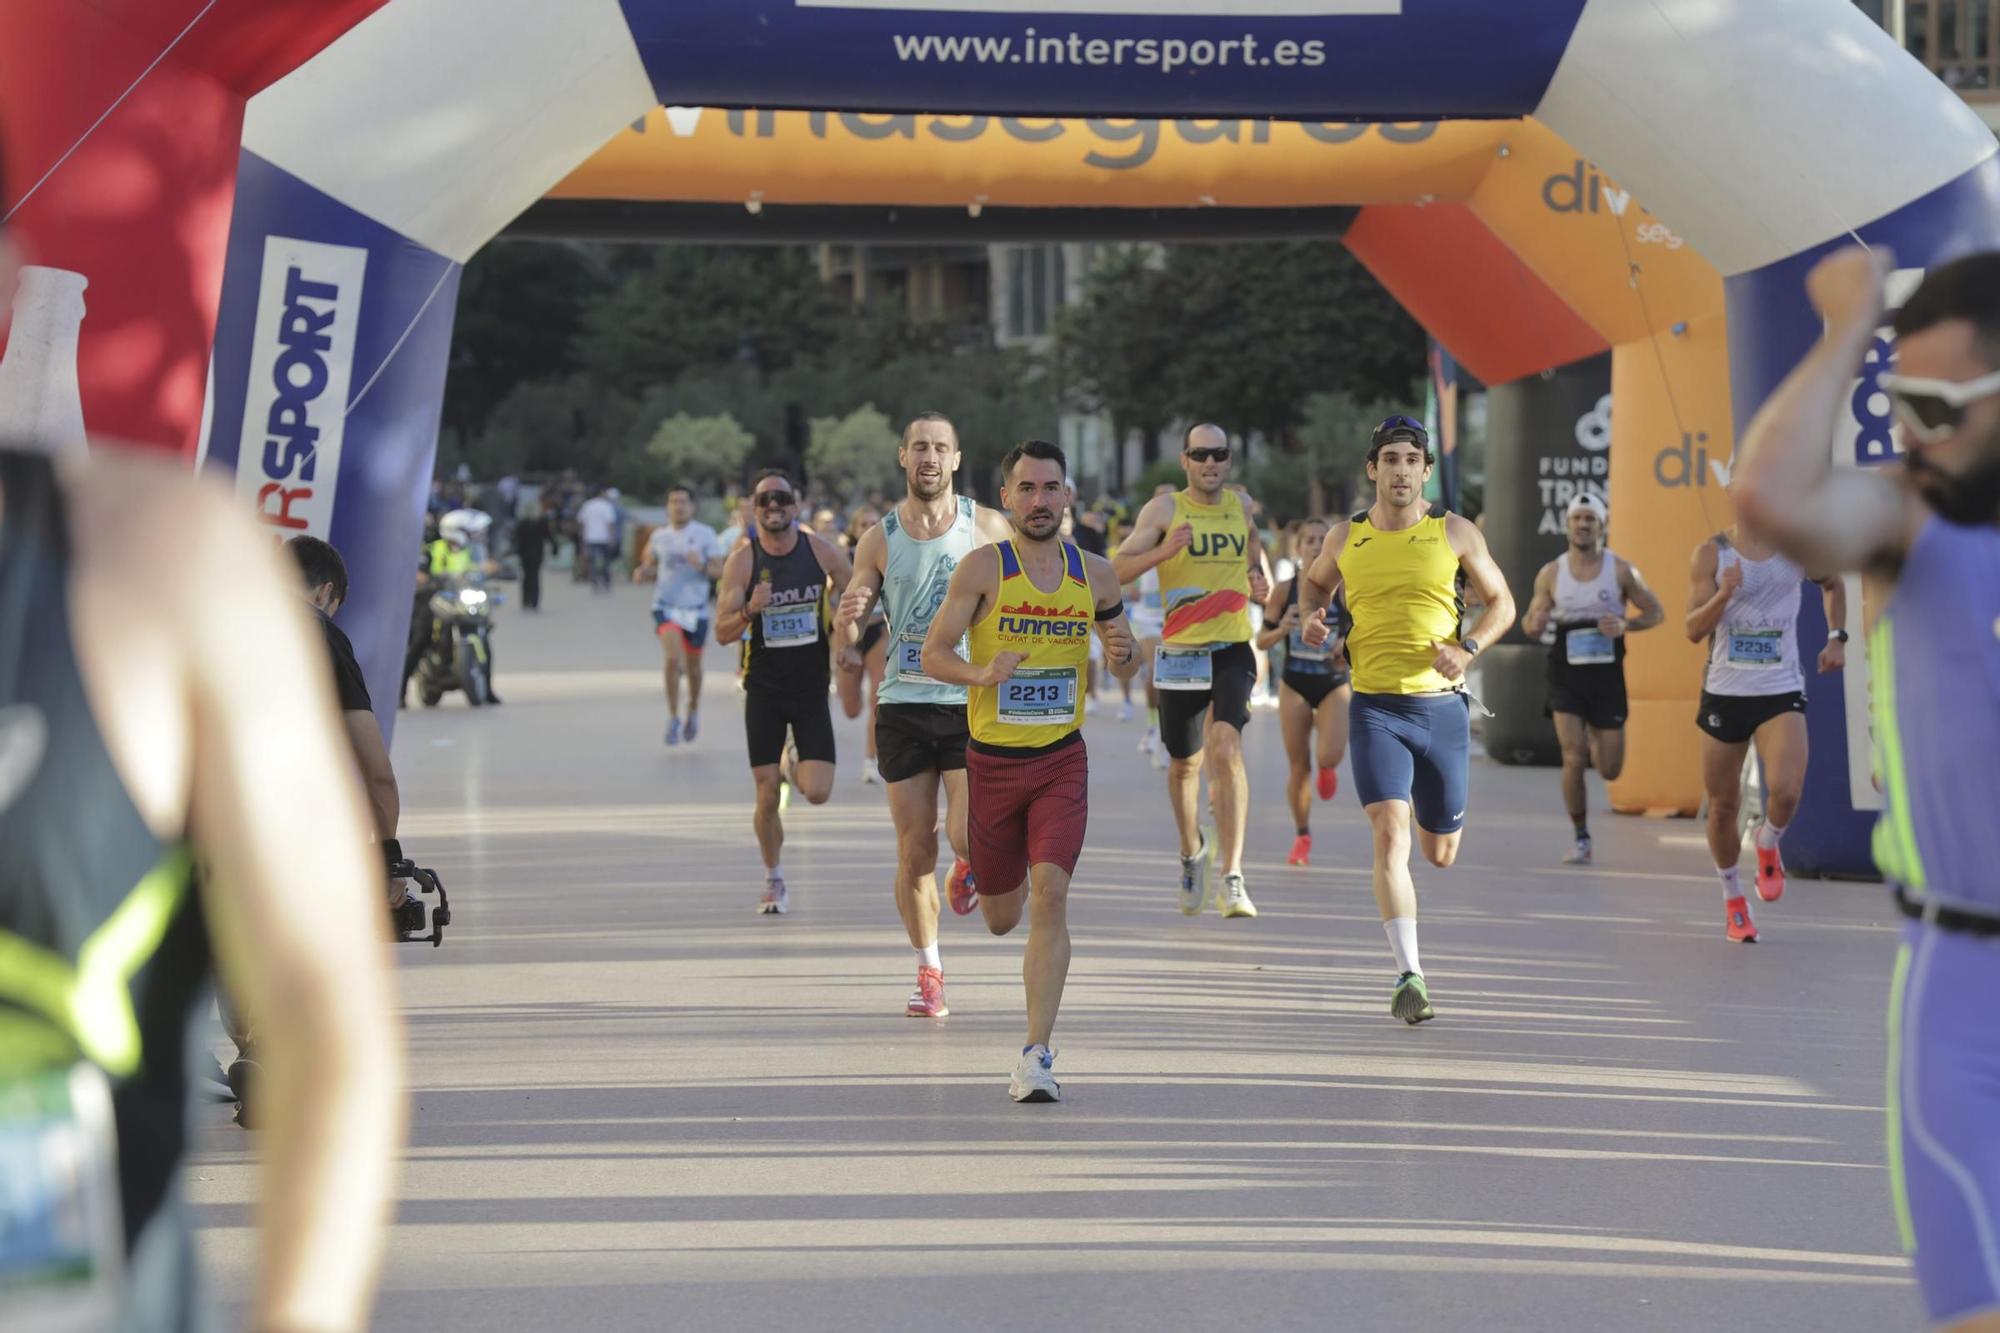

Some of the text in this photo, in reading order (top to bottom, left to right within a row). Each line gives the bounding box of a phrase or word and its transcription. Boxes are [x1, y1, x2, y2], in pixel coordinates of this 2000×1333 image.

[893, 27, 1327, 73] www.intersport.es
[1187, 532, 1245, 557] UPV
[771, 618, 804, 631] 2131
[998, 616, 1088, 636] runners
[998, 634, 1028, 644] CIUTAT
[1735, 640, 1773, 654] 2235
[1009, 685, 1059, 702] 2213
